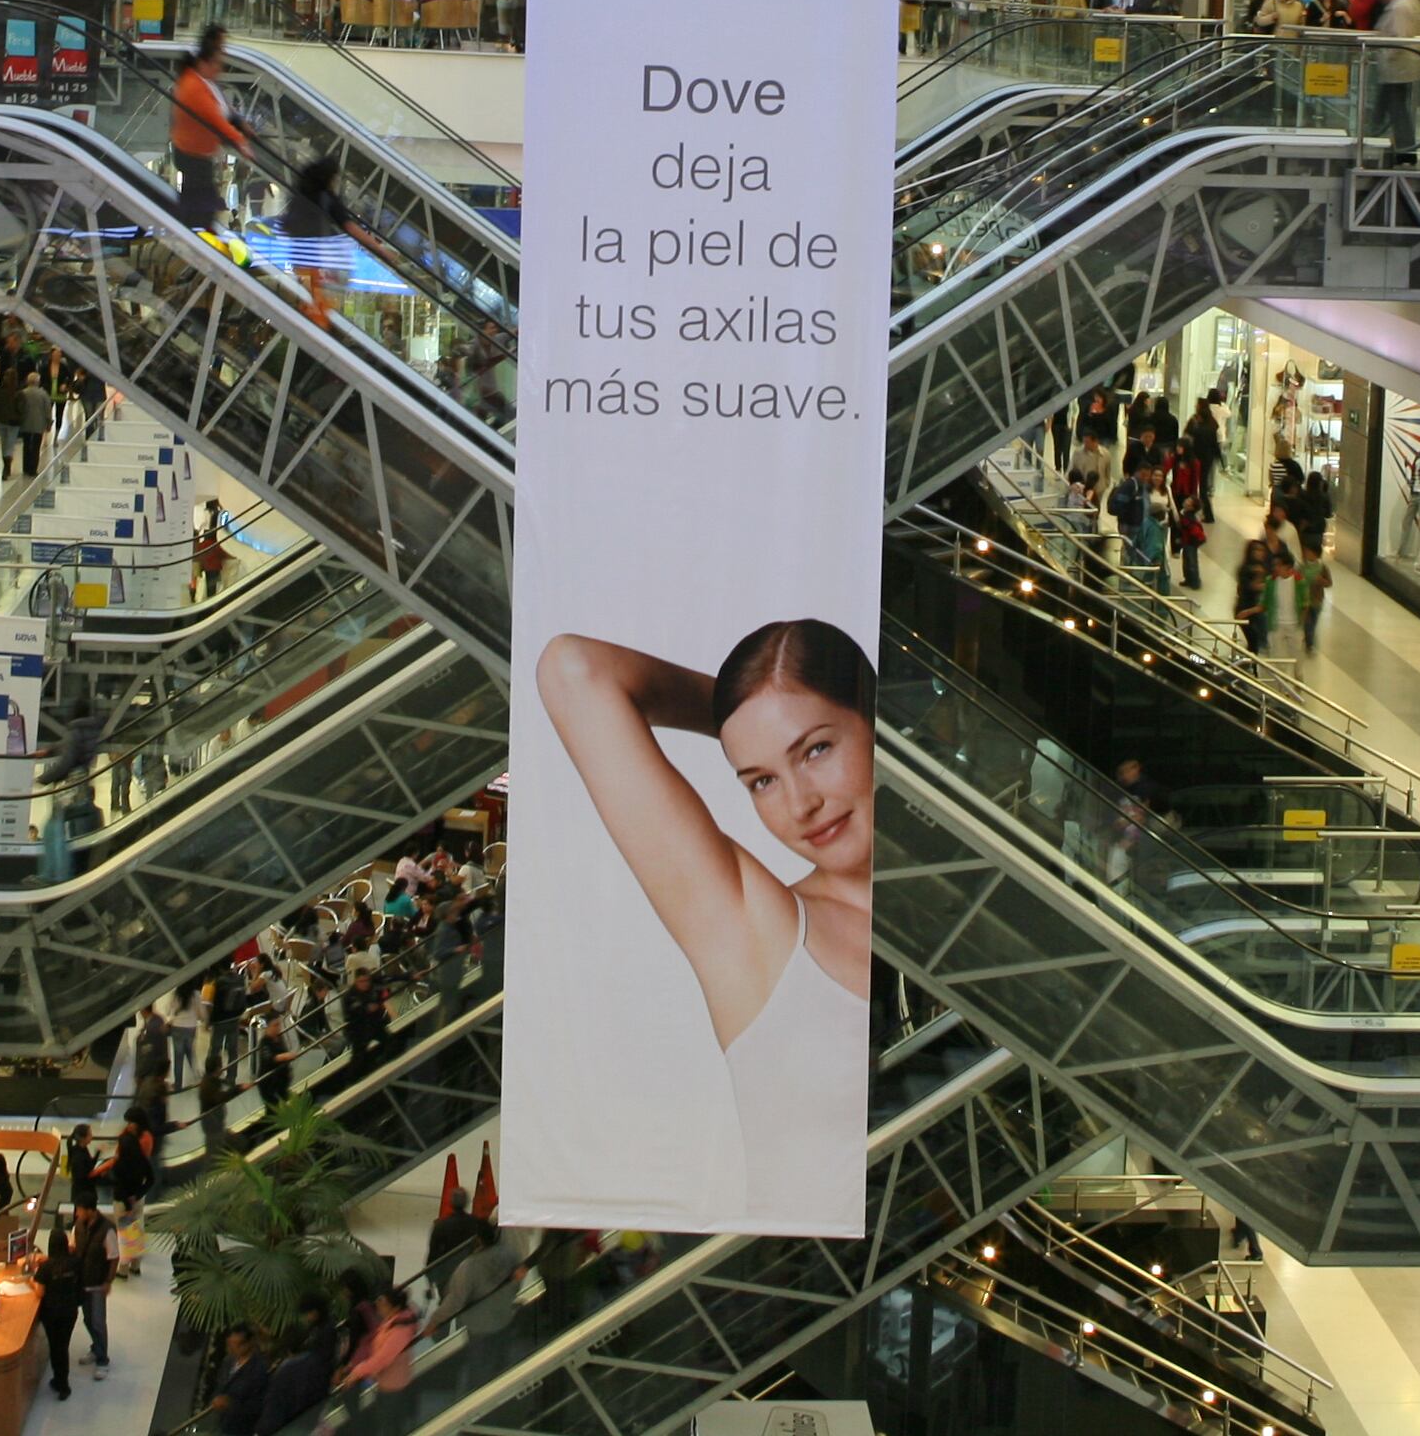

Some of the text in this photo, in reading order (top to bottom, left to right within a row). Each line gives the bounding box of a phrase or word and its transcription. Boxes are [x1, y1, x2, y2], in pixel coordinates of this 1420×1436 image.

[642, 65, 786, 116] Dove
[652, 141, 772, 202] deja
[581, 215, 837, 276] la piel de
[575, 294, 837, 345] tus axilas
[545, 368, 860, 421] más suave.
